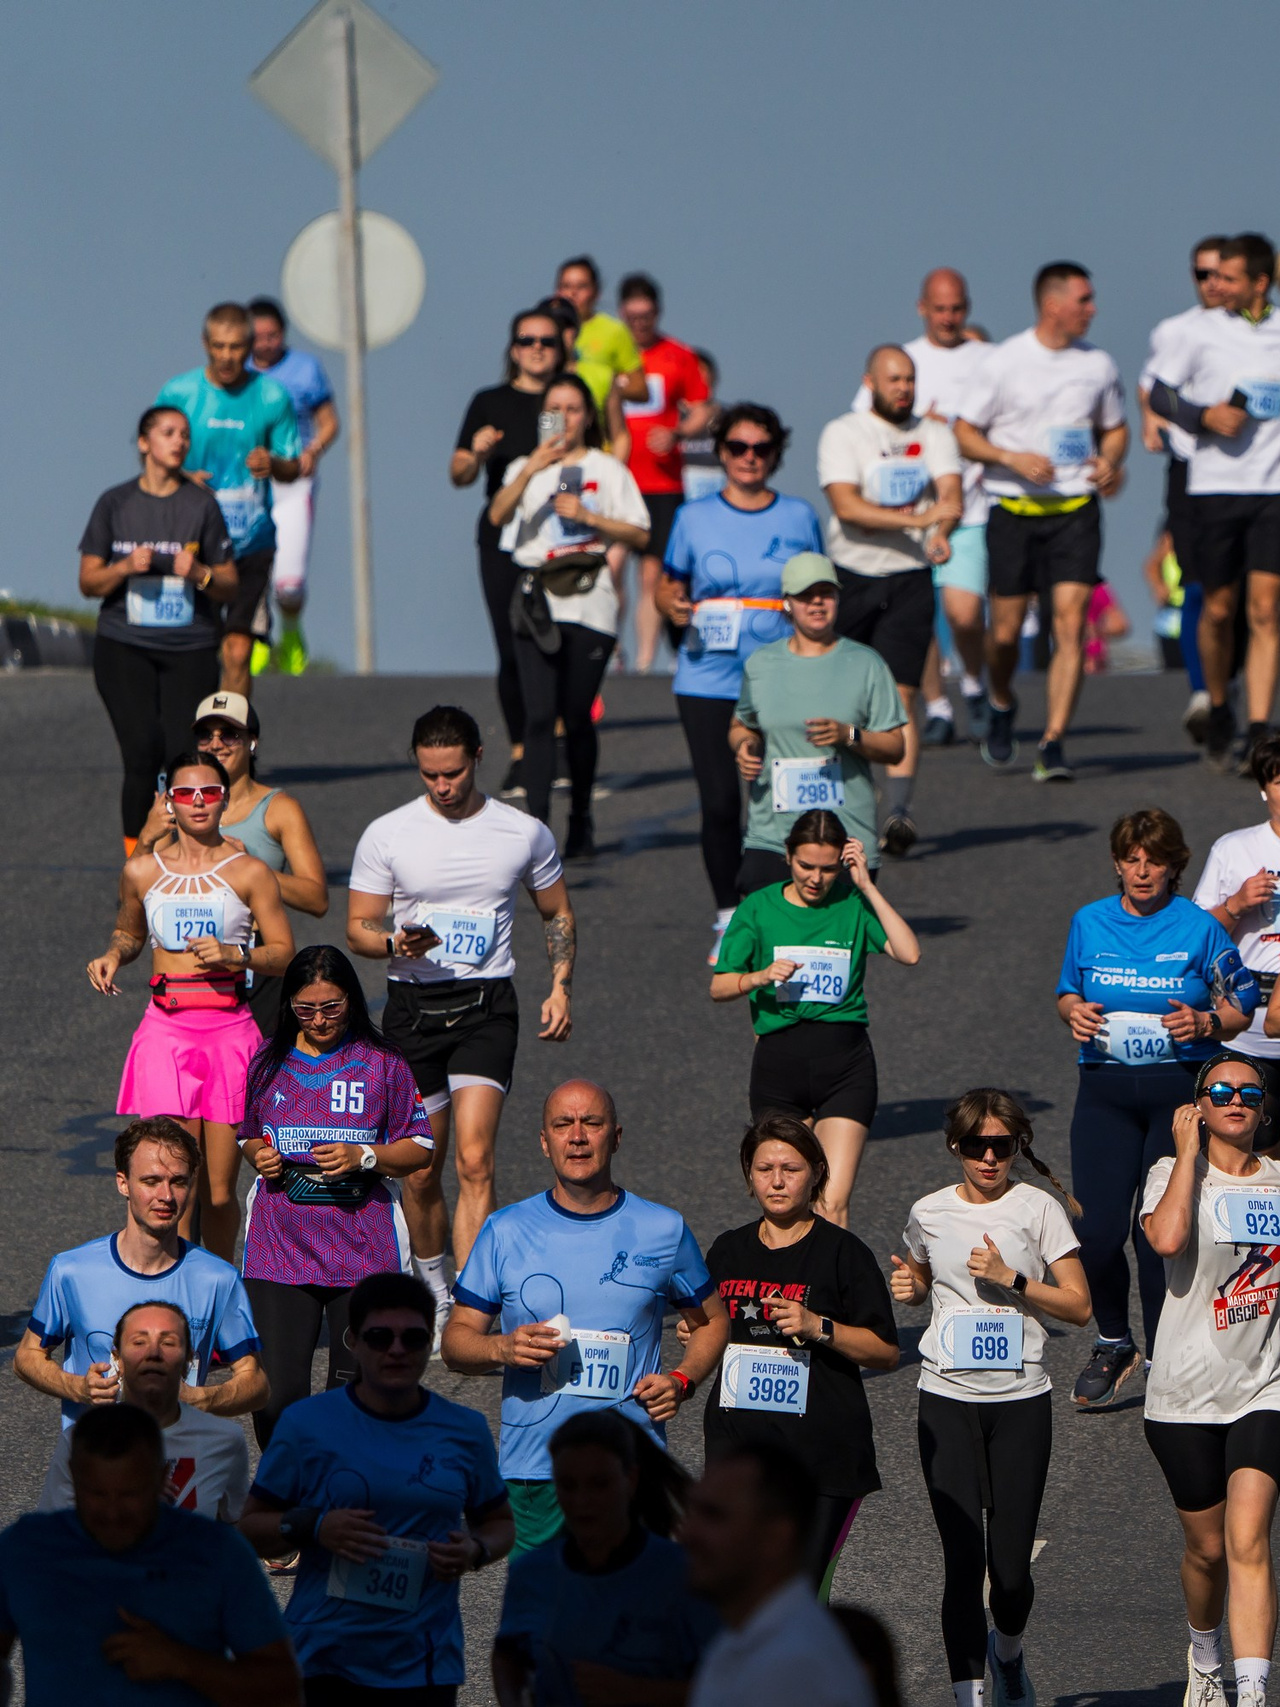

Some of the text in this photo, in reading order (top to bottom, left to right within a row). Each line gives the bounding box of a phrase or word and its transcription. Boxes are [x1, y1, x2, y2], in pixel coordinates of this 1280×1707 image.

[797, 780, 837, 804] 2981
[175, 907, 213, 918] СВЕТЛАНА
[174, 920, 217, 942] 1279
[452, 920, 477, 931] АРТЕМ
[445, 932, 486, 957] 1278
[810, 961, 833, 972] ЮЛИЯ
[800, 974, 843, 997] 2428
[1091, 972, 1184, 989] ГОРИЗОНТ
[1122, 1038, 1167, 1059] 1342
[331, 1080, 365, 1114] 95
[278, 1128, 377, 1143] ЭНДОХИРУРГИЧЕСКИЙ
[280, 1141, 311, 1154] ЦЕНТР
[1248, 1200, 1274, 1211] ОЛЬГА
[1245, 1213, 1280, 1237] 923
[758, 1281, 782, 1299] TO
[782, 1283, 806, 1302] ME
[975, 1322, 1004, 1333] МАРИЯ
[1215, 1303, 1258, 1331] BOSCO
[584, 1347, 610, 1360] ЮРИЙ
[971, 1336, 1009, 1361] 698
[570, 1362, 620, 1390] 5170
[752, 1362, 800, 1377] ЕКАТЕРИНА
[748, 1376, 800, 1405] 3982
[366, 1568, 409, 1600] 349
